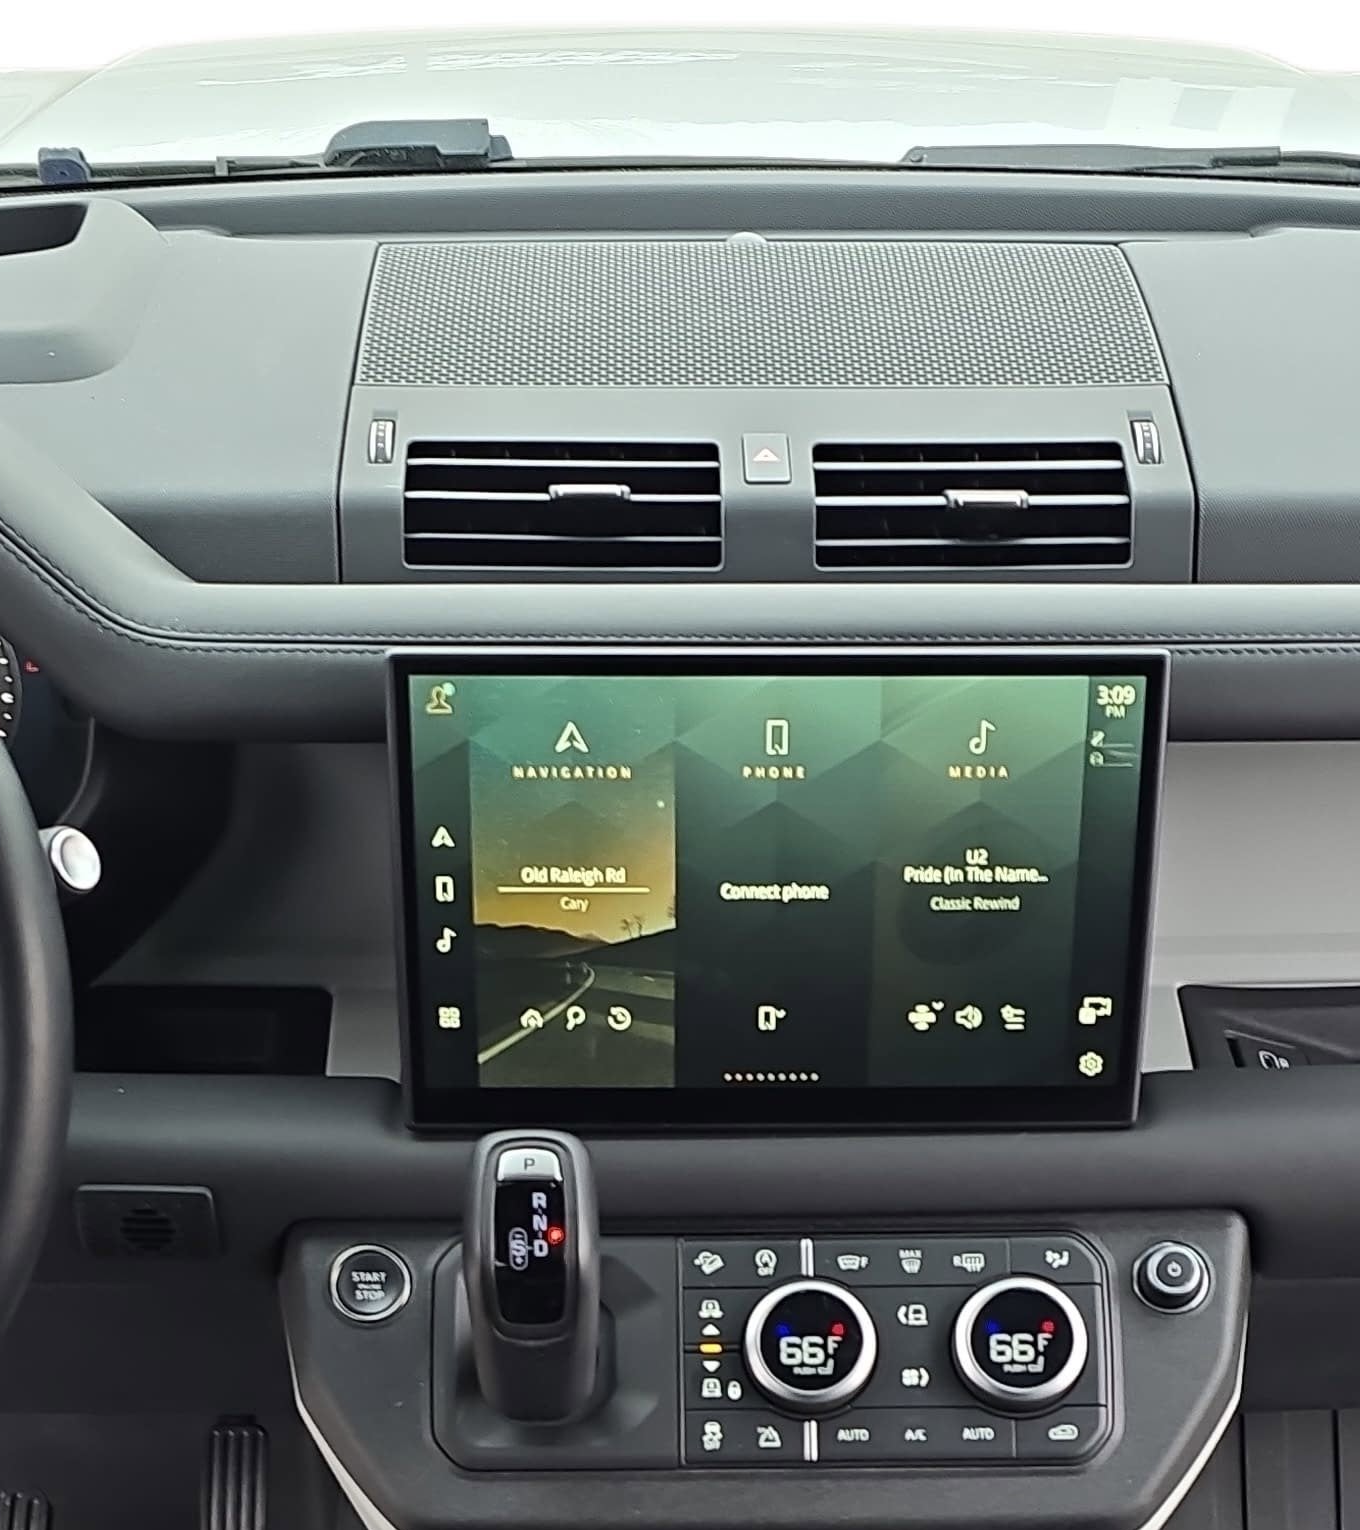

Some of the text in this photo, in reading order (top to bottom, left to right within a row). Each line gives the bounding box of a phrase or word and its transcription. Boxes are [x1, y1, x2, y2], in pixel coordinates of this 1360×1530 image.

[1097, 685, 1136, 706] 3:09
[1105, 705, 1126, 718] PM
[513, 766, 632, 780] NAVIGATION
[743, 766, 806, 780] PHONE
[949, 765, 1009, 779] MEDIA
[965, 849, 989, 866] U2
[521, 867, 627, 886] Old Raleigh Rd
[904, 865, 942, 884] Pride
[943, 866, 964, 885] (In
[966, 866, 993, 883] The
[720, 882, 830, 903] Connect phone
[560, 896, 589, 913] Cary
[930, 896, 1020, 912] Classic Rewind
[524, 1158, 535, 1170] P
[532, 1192, 547, 1209] R
[532, 1214, 547, 1231] N
[533, 1239, 548, 1257] D
[899, 1250, 922, 1258] MAX
[351, 1271, 386, 1282] START
[355, 1290, 385, 1300] STOP
[779, 1336, 825, 1366] 66
[989, 1334, 1035, 1363] 66
[837, 1429, 869, 1441] AUTO
[962, 1428, 994, 1440] AUTO
